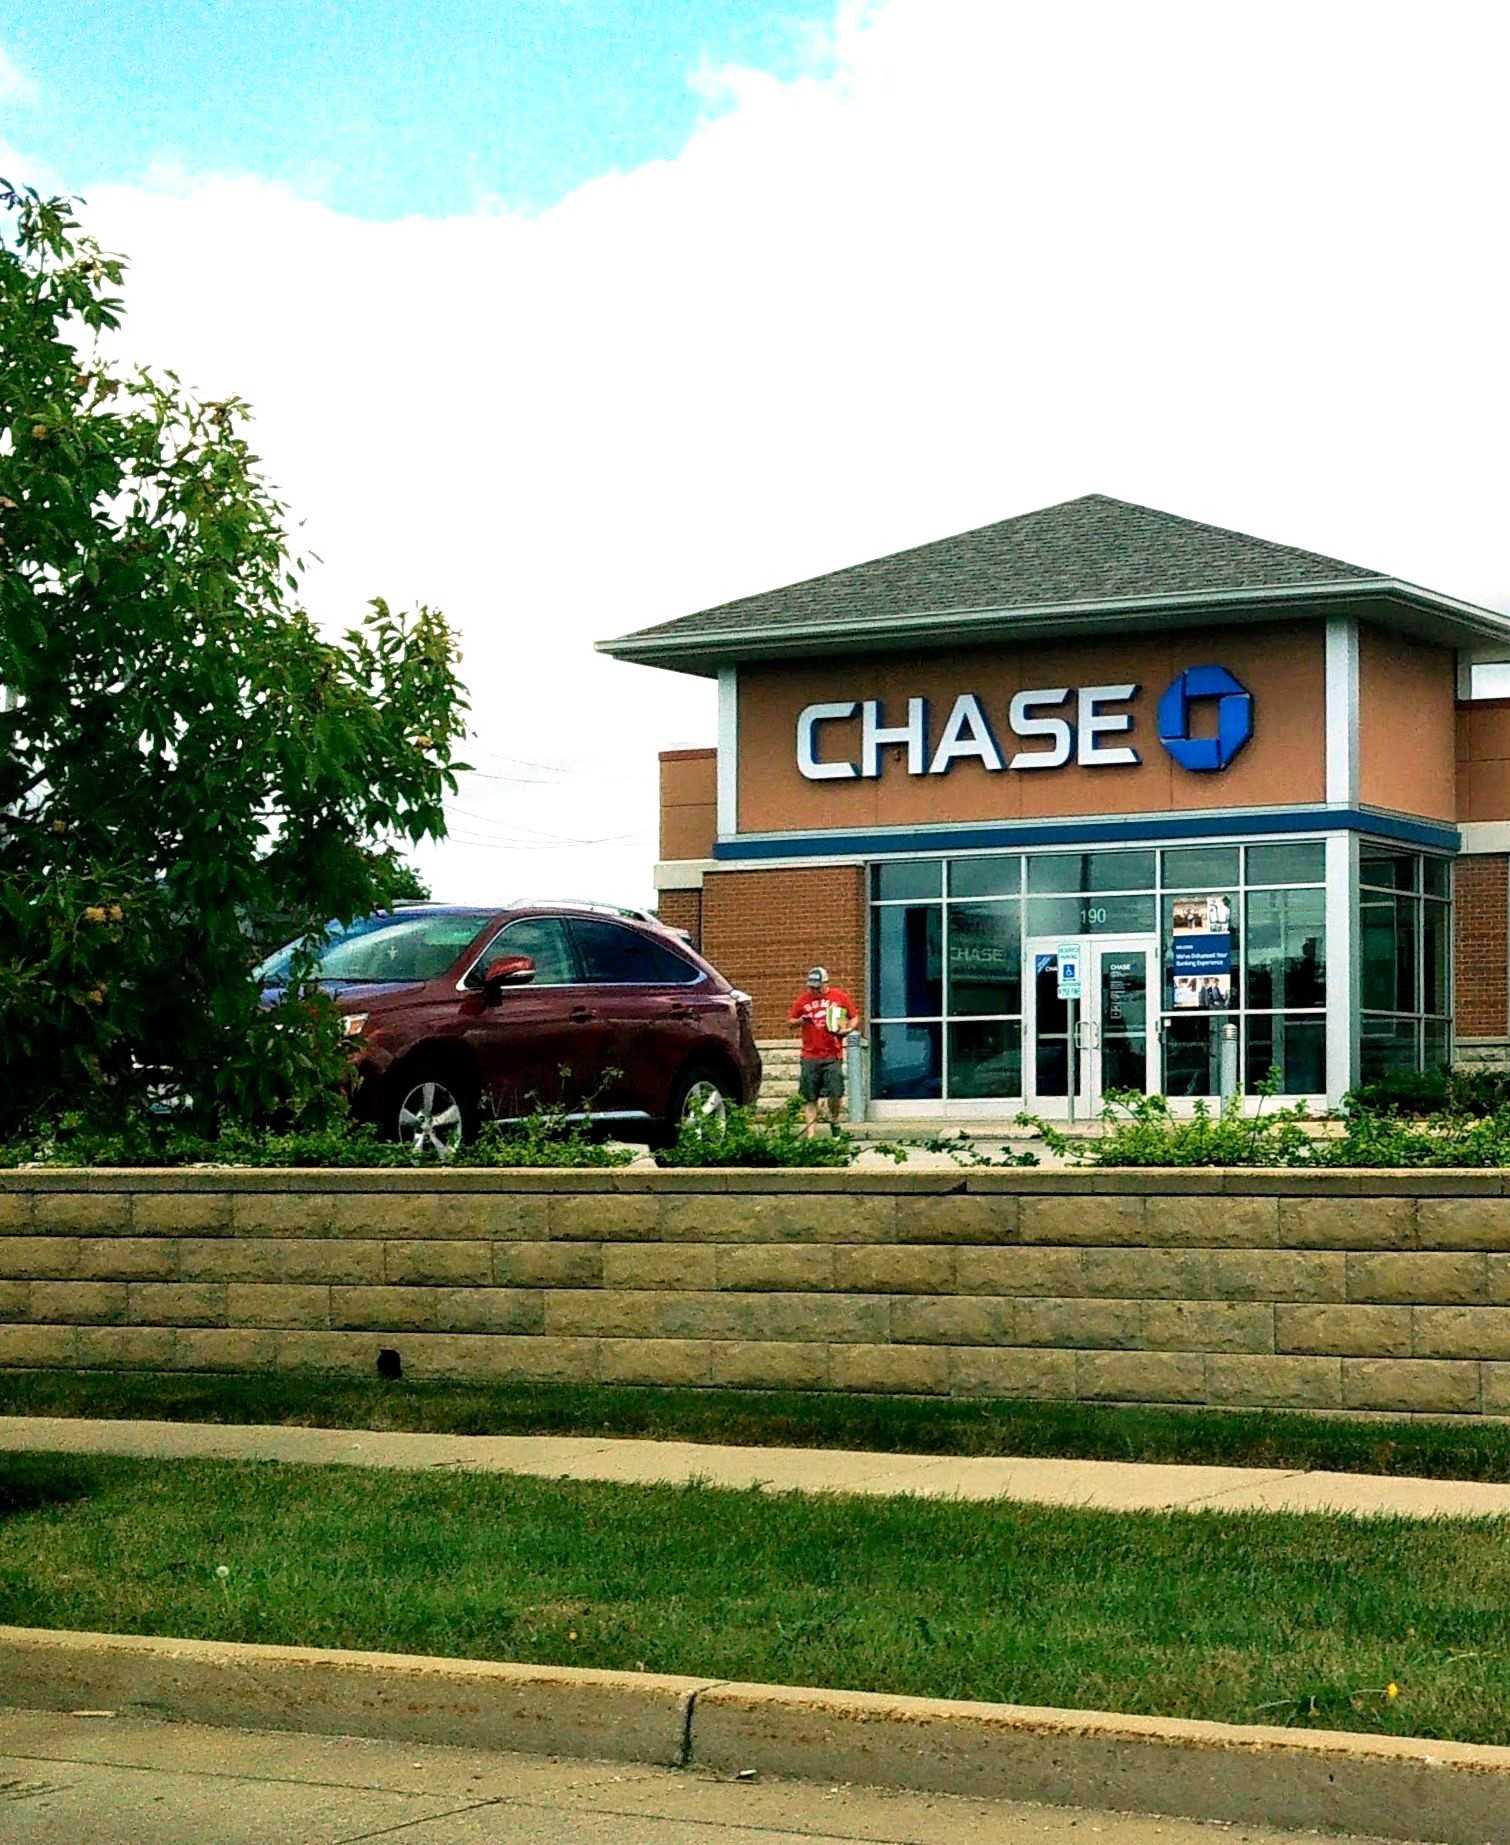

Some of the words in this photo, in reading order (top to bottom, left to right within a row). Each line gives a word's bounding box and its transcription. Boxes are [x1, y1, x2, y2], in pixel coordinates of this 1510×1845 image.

[796, 683, 1142, 780] CHASE
[1080, 908, 1106, 924] 190
[950, 947, 1004, 962] CHASE
